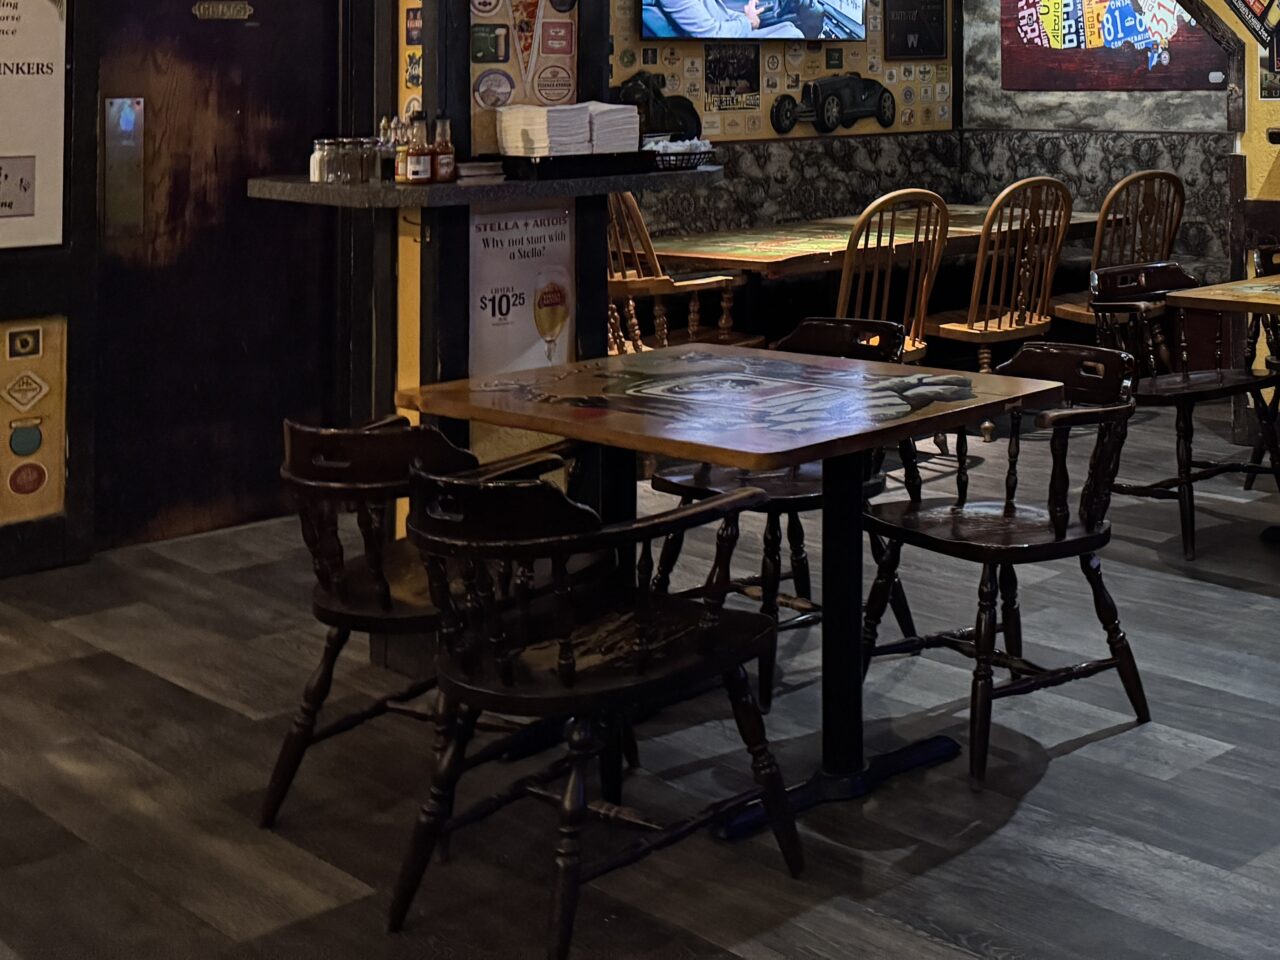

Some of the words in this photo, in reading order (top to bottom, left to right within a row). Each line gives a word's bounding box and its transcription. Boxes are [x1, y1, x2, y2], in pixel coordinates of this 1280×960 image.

[475, 220, 519, 232] STELLA
[533, 216, 567, 228] ARTOIS
[482, 236, 504, 249] Why
[508, 235, 524, 248] not
[526, 234, 546, 245] start
[548, 231, 566, 243] with
[509, 251, 515, 260] a
[518, 246, 546, 259] Stella?
